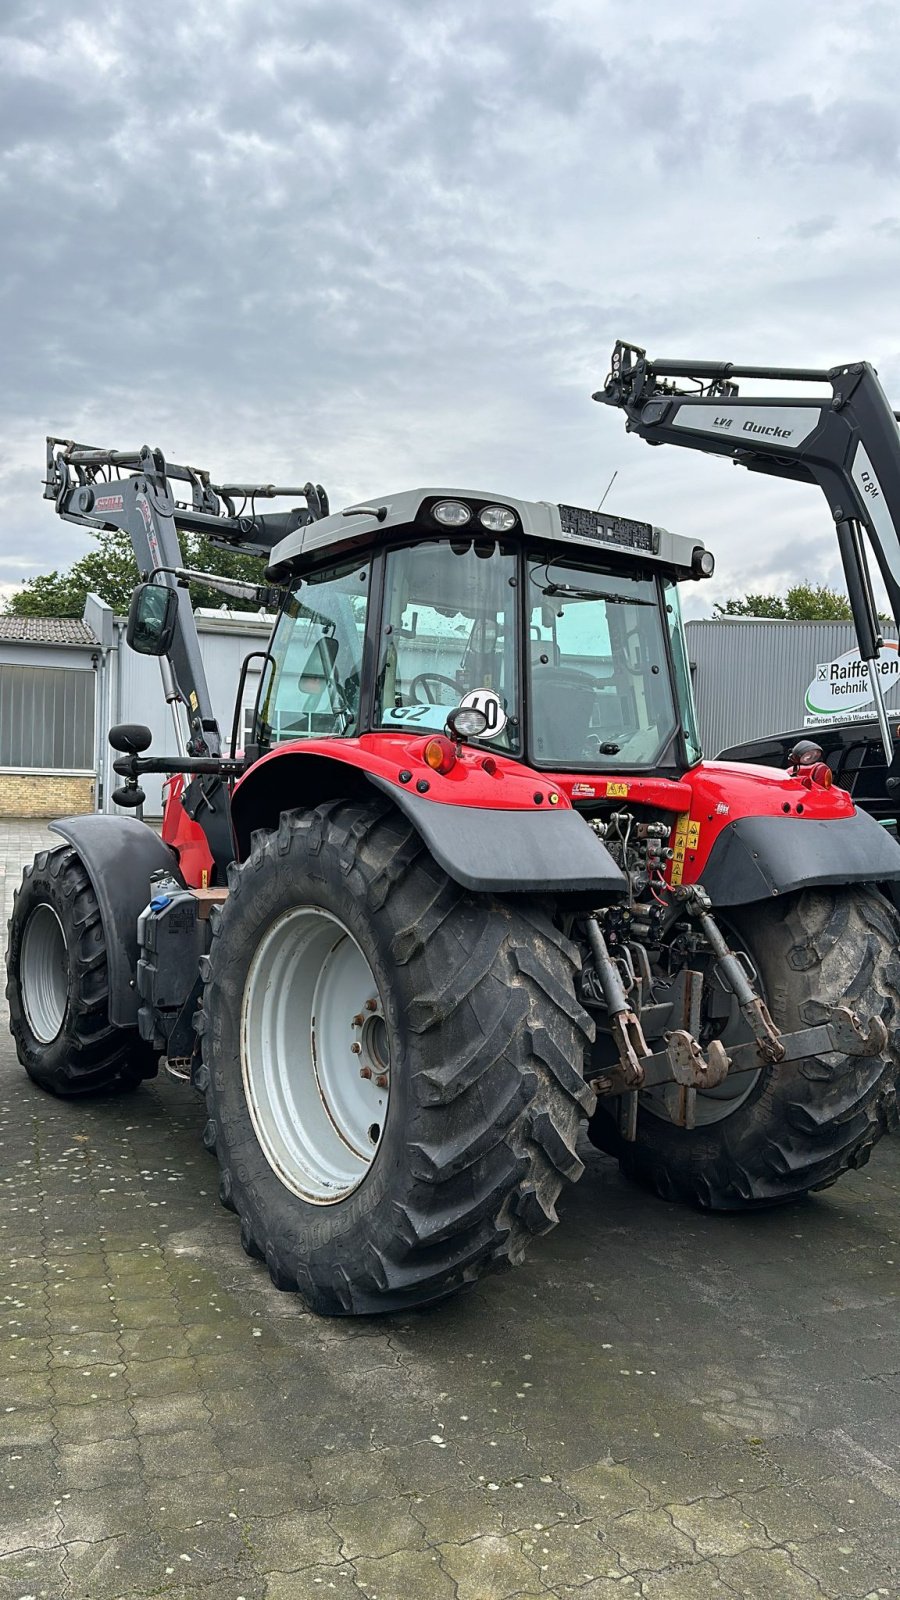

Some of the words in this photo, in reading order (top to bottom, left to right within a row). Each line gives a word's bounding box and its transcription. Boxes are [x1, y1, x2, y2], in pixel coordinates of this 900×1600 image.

[742, 421, 792, 438] Quicke
[830, 680, 868, 695] Technik
[390, 706, 431, 721] G2
